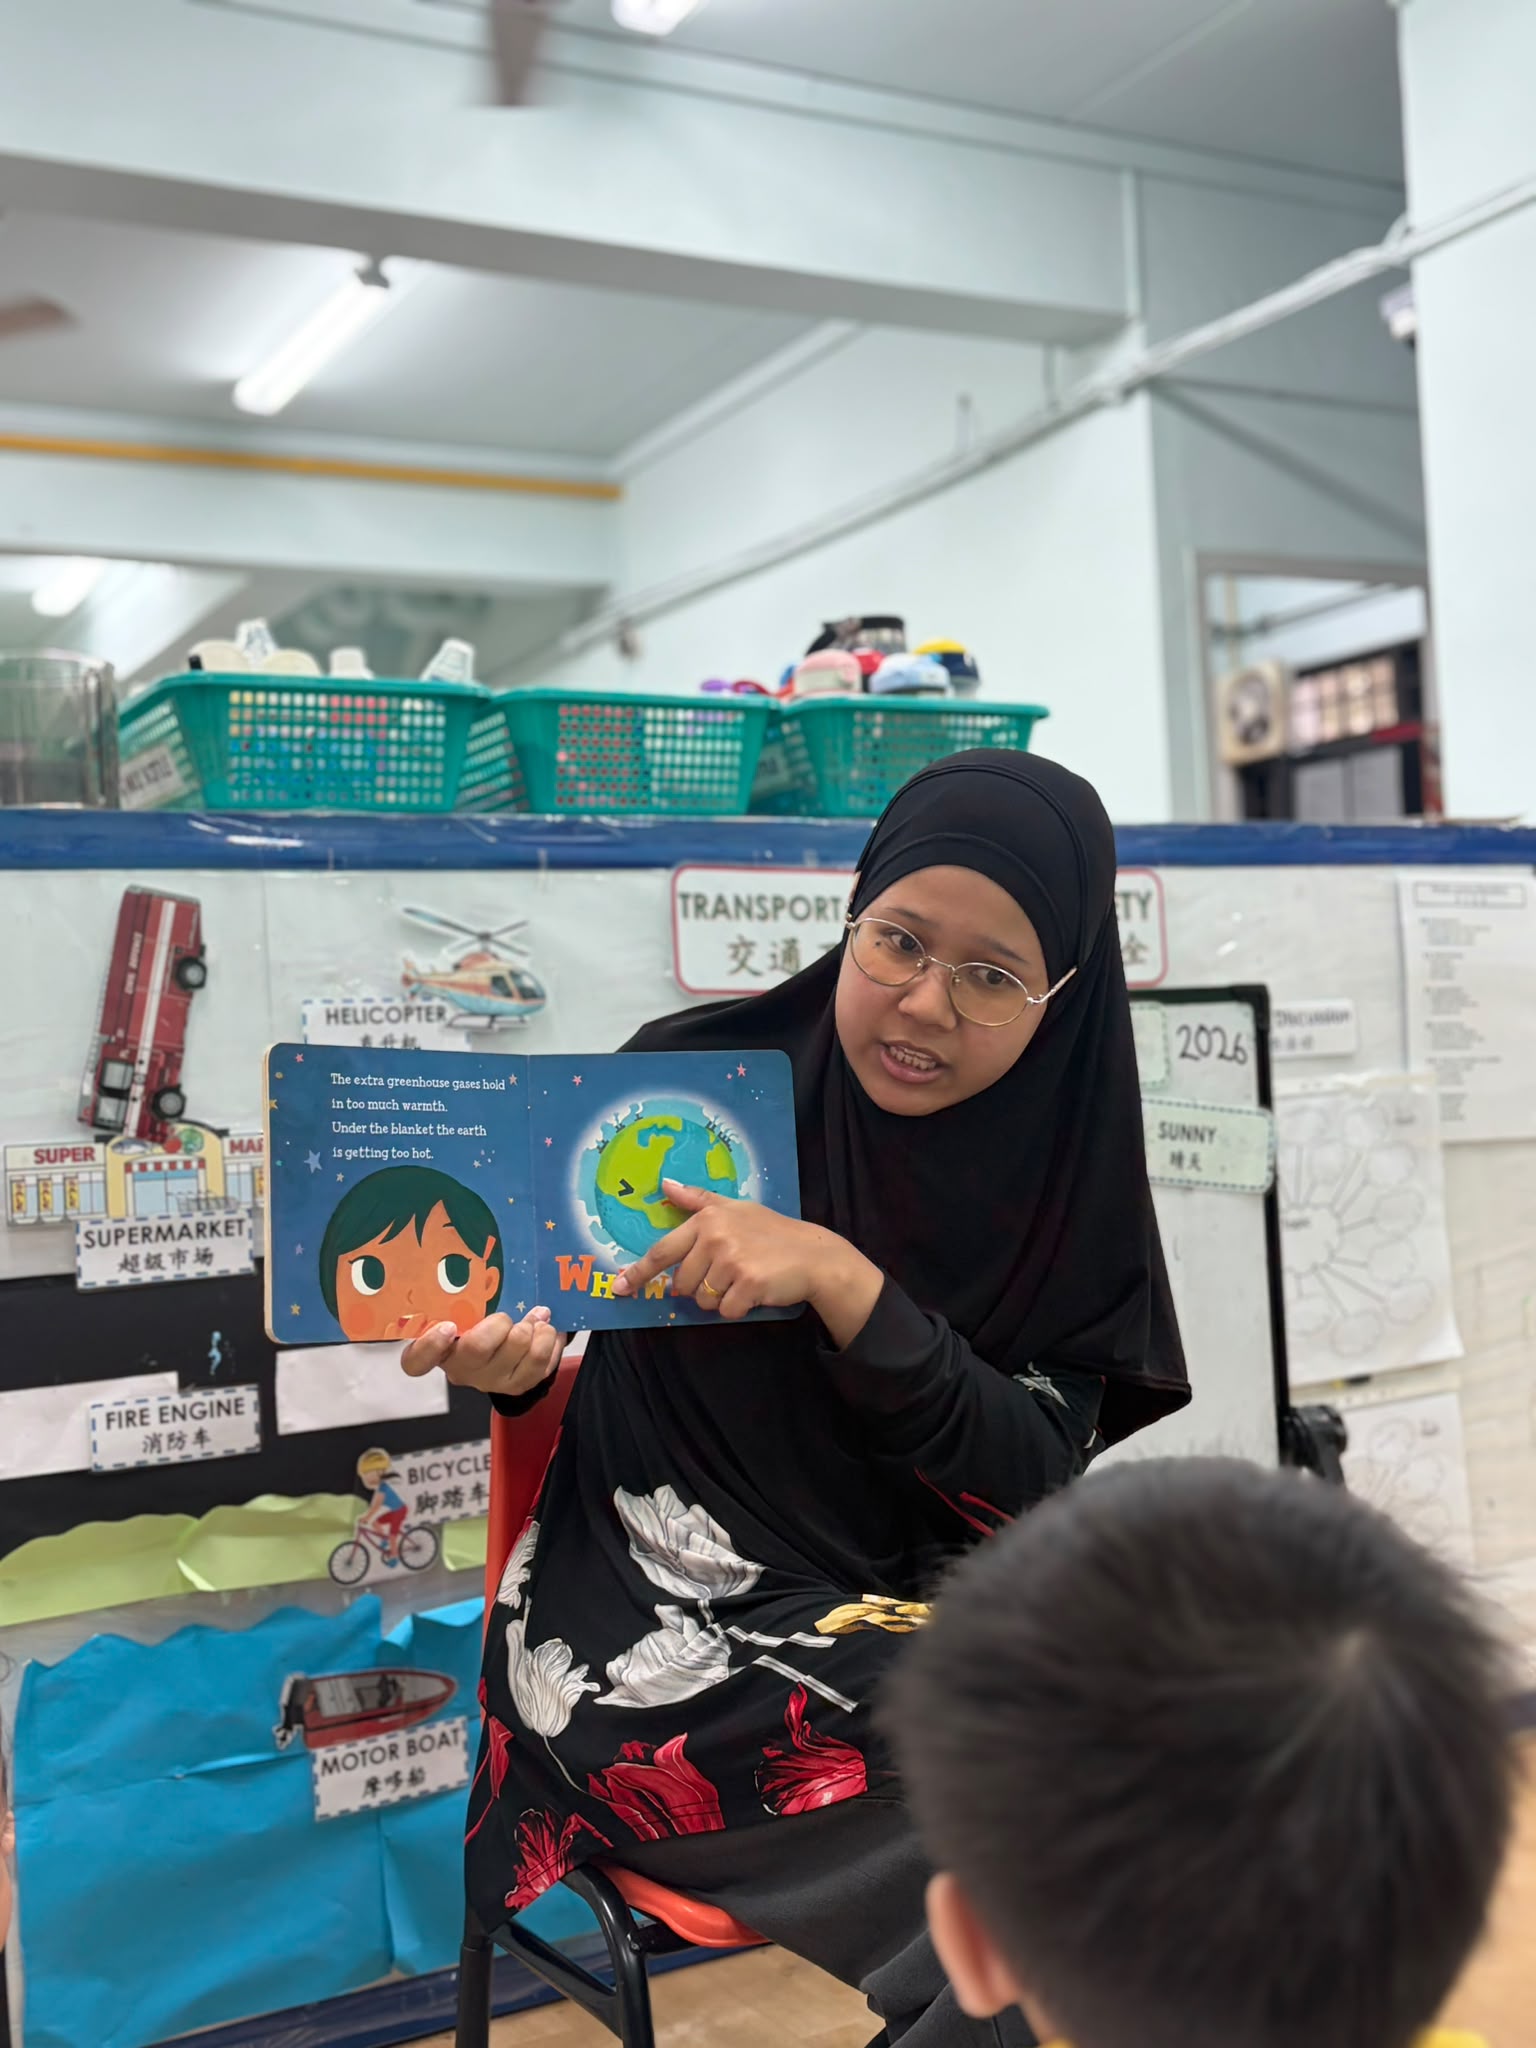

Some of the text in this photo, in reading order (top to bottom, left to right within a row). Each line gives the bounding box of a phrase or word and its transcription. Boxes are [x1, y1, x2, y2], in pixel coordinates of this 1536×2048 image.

[727, 934, 837, 977] 交通
[325, 1005, 447, 1025] HELICOPTER
[1176, 1024, 1249, 1067] 2026
[331, 1073, 506, 1091] The extra greenhouse gases hold
[331, 1098, 448, 1112] in too much warmth.
[332, 1121, 487, 1136] Under the blanket the earth
[1158, 1121, 1216, 1144] SUNNY
[34, 1147, 95, 1164] SUPER
[332, 1146, 434, 1160] is getting too hot.
[84, 1219, 245, 1249] SUPERMARKET
[118, 1247, 214, 1274] 超级市场
[555, 1255, 681, 1299] WHW
[106, 1397, 245, 1430] FIRE ENGINE
[142, 1427, 211, 1454] 消防车
[408, 1454, 491, 1484] BICYCLE
[321, 1728, 460, 1776] MOTOR BOAT
